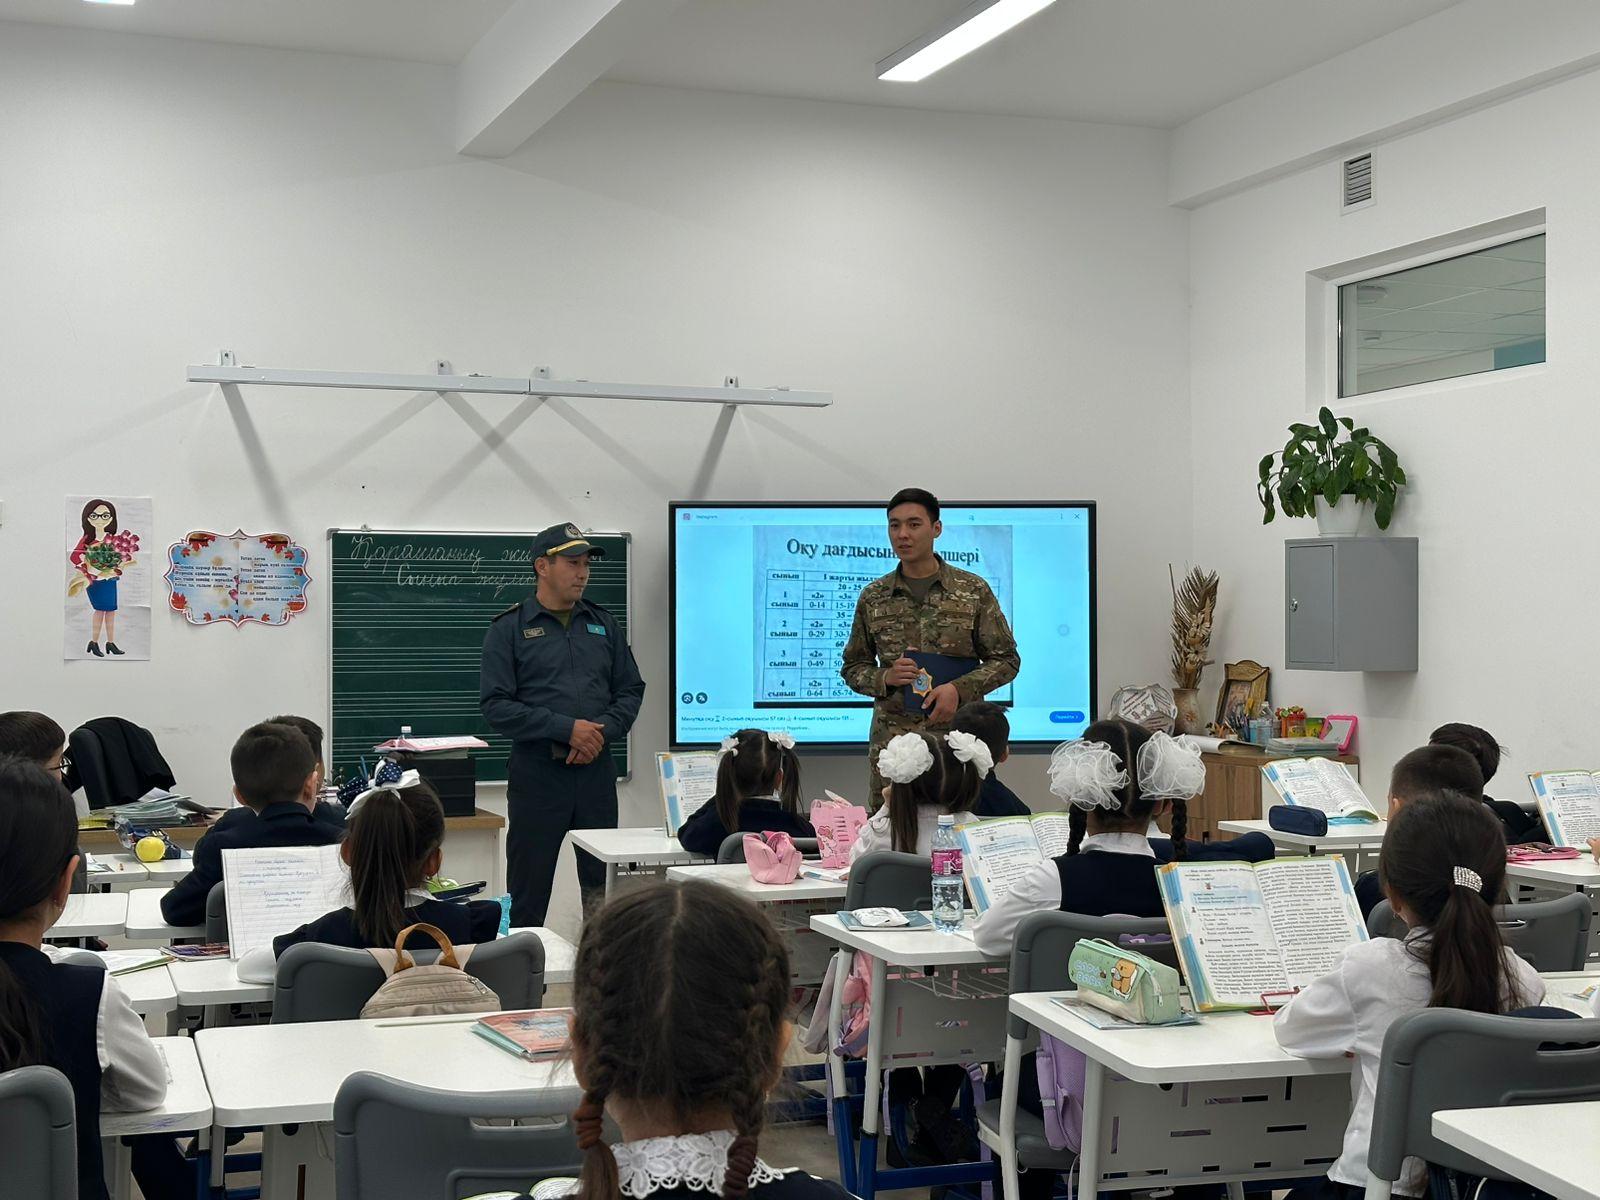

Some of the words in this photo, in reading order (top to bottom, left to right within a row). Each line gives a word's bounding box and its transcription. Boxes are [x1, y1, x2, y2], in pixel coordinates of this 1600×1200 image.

[786, 538, 818, 559] Оқу
[821, 543, 898, 559] дағдысын
[939, 547, 979, 566] лшері
[780, 650, 786, 658] 3
[780, 680, 786, 688] 4
